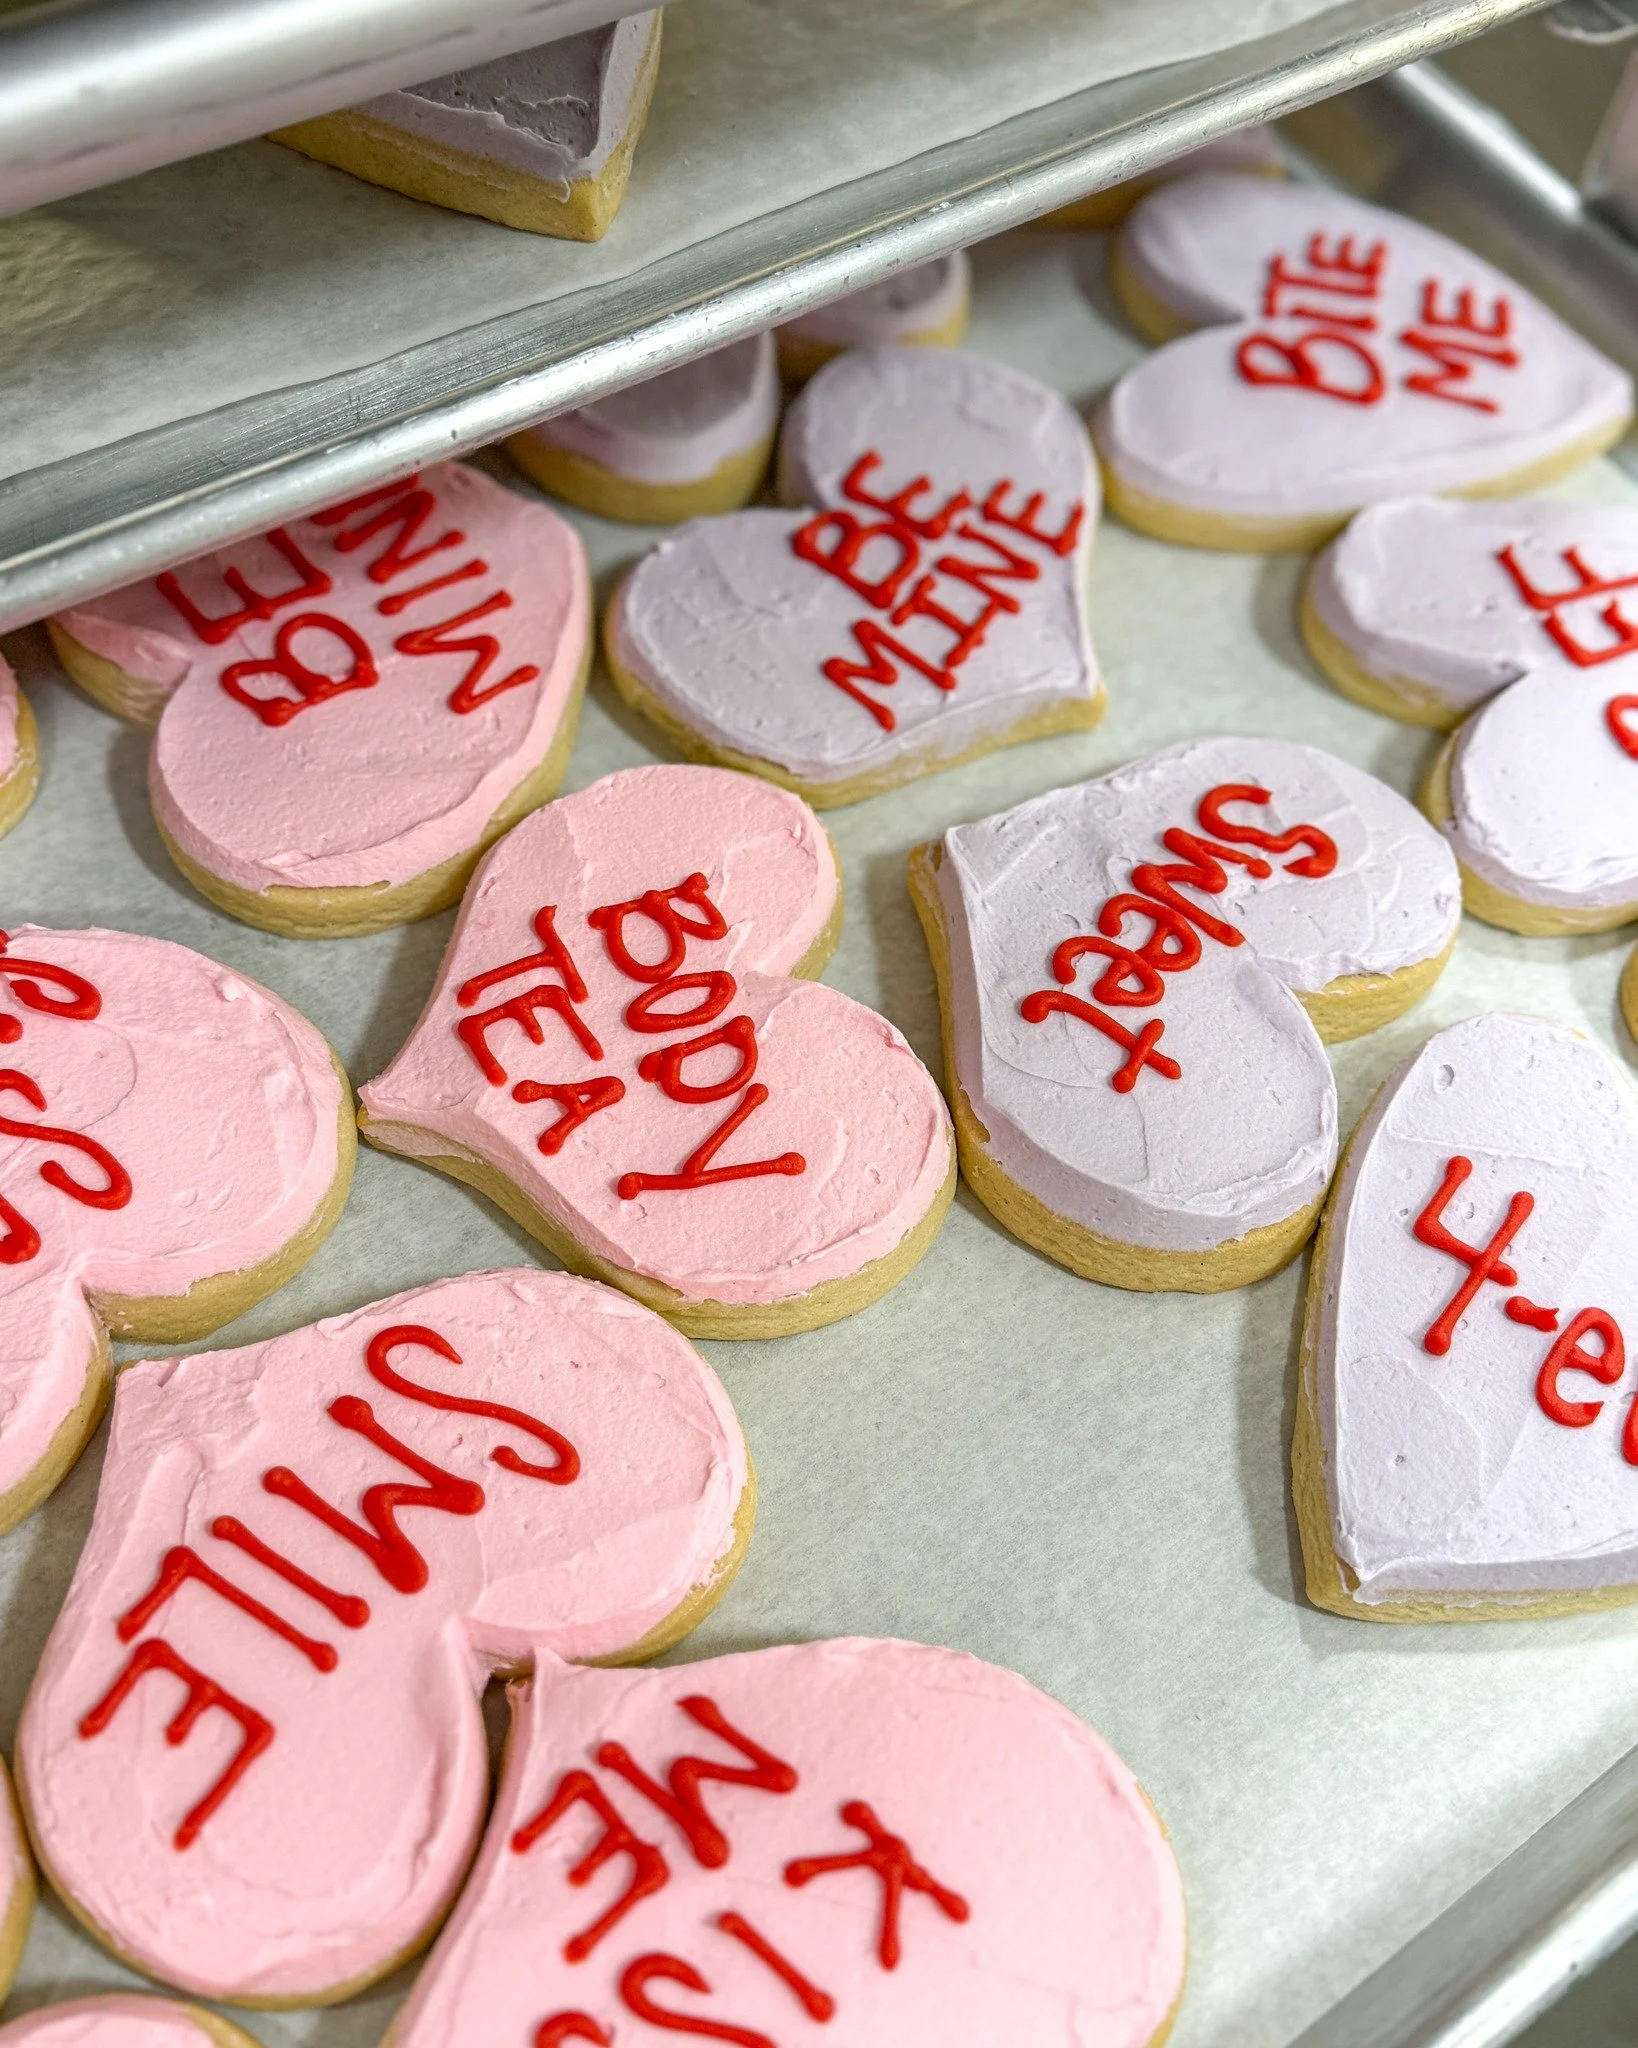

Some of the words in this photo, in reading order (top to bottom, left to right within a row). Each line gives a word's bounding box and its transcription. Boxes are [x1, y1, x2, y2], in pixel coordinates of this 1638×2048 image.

[1236, 230, 1386, 409] BITE
[1399, 281, 1520, 415] ME
[153, 529, 380, 728] BE
[790, 449, 974, 611] BE
[821, 479, 1087, 733] MINE
[456, 904, 628, 1157] TEA
[587, 871, 808, 1201] BODY
[1413, 1155, 1638, 1467] 4-e
[78, 1324, 582, 1851] SMILE
[510, 1695, 799, 1965] ME
[533, 1800, 970, 2048] KIS
